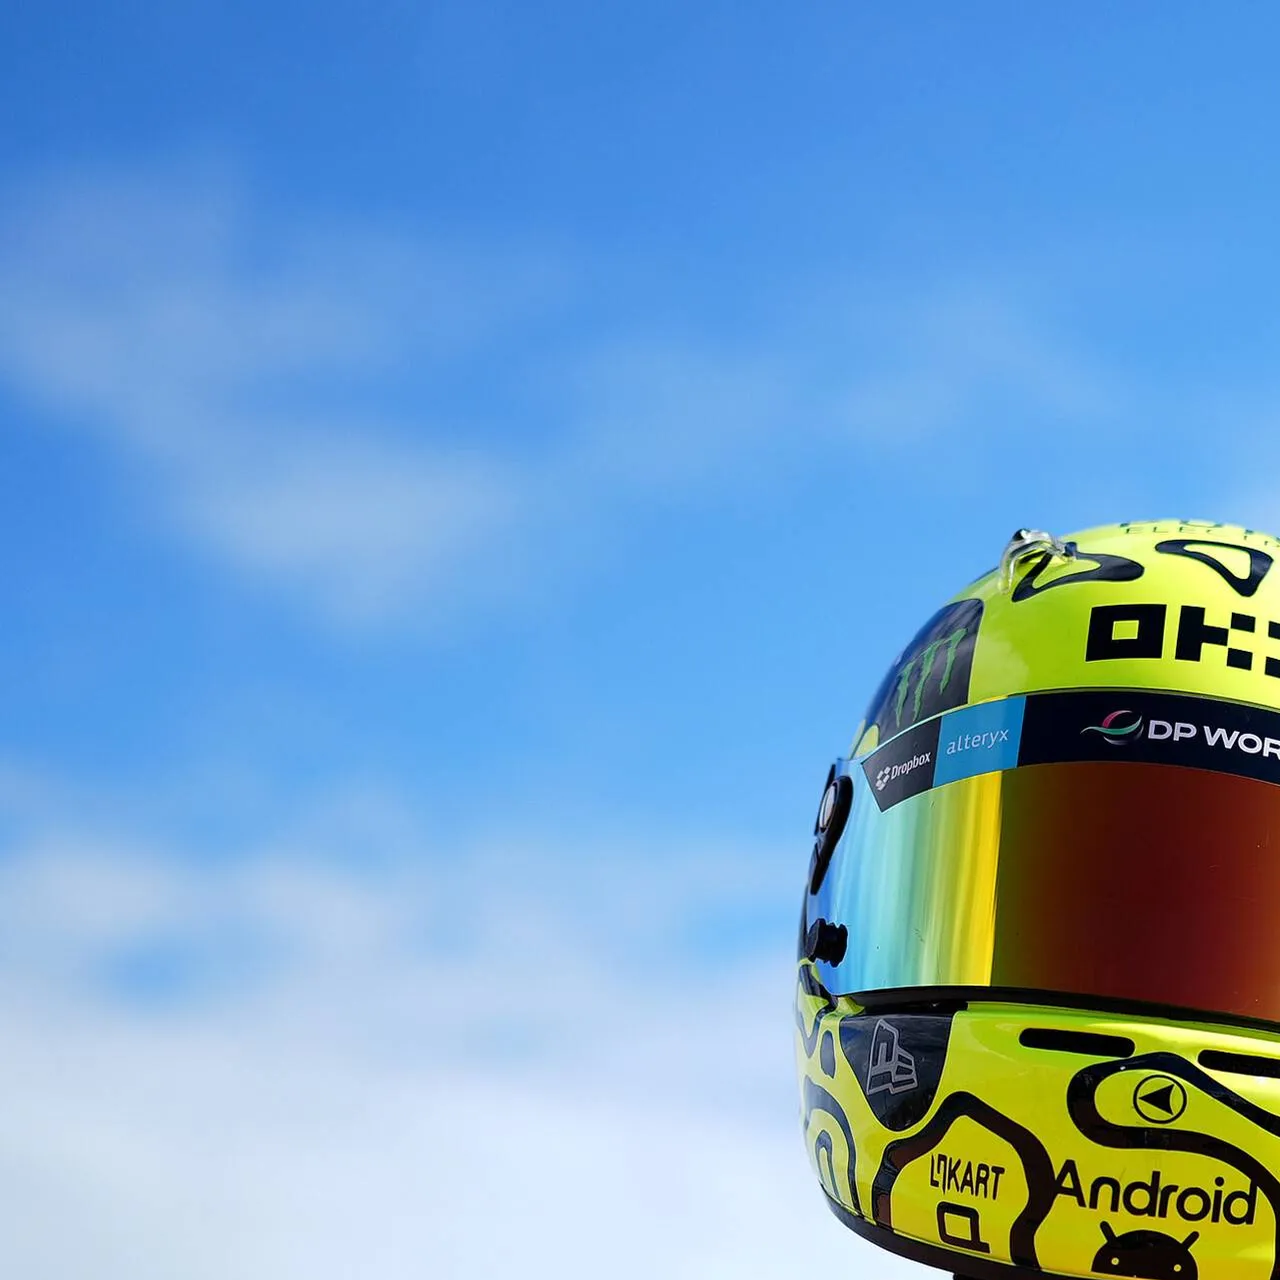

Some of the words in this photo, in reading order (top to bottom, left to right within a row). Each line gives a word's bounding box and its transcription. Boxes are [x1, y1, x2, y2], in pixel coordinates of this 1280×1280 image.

[947, 728, 1009, 755] alteryx
[1147, 718, 1197, 742] DP
[891, 751, 931, 781] Dropbox
[1054, 1160, 1257, 1226] Android
